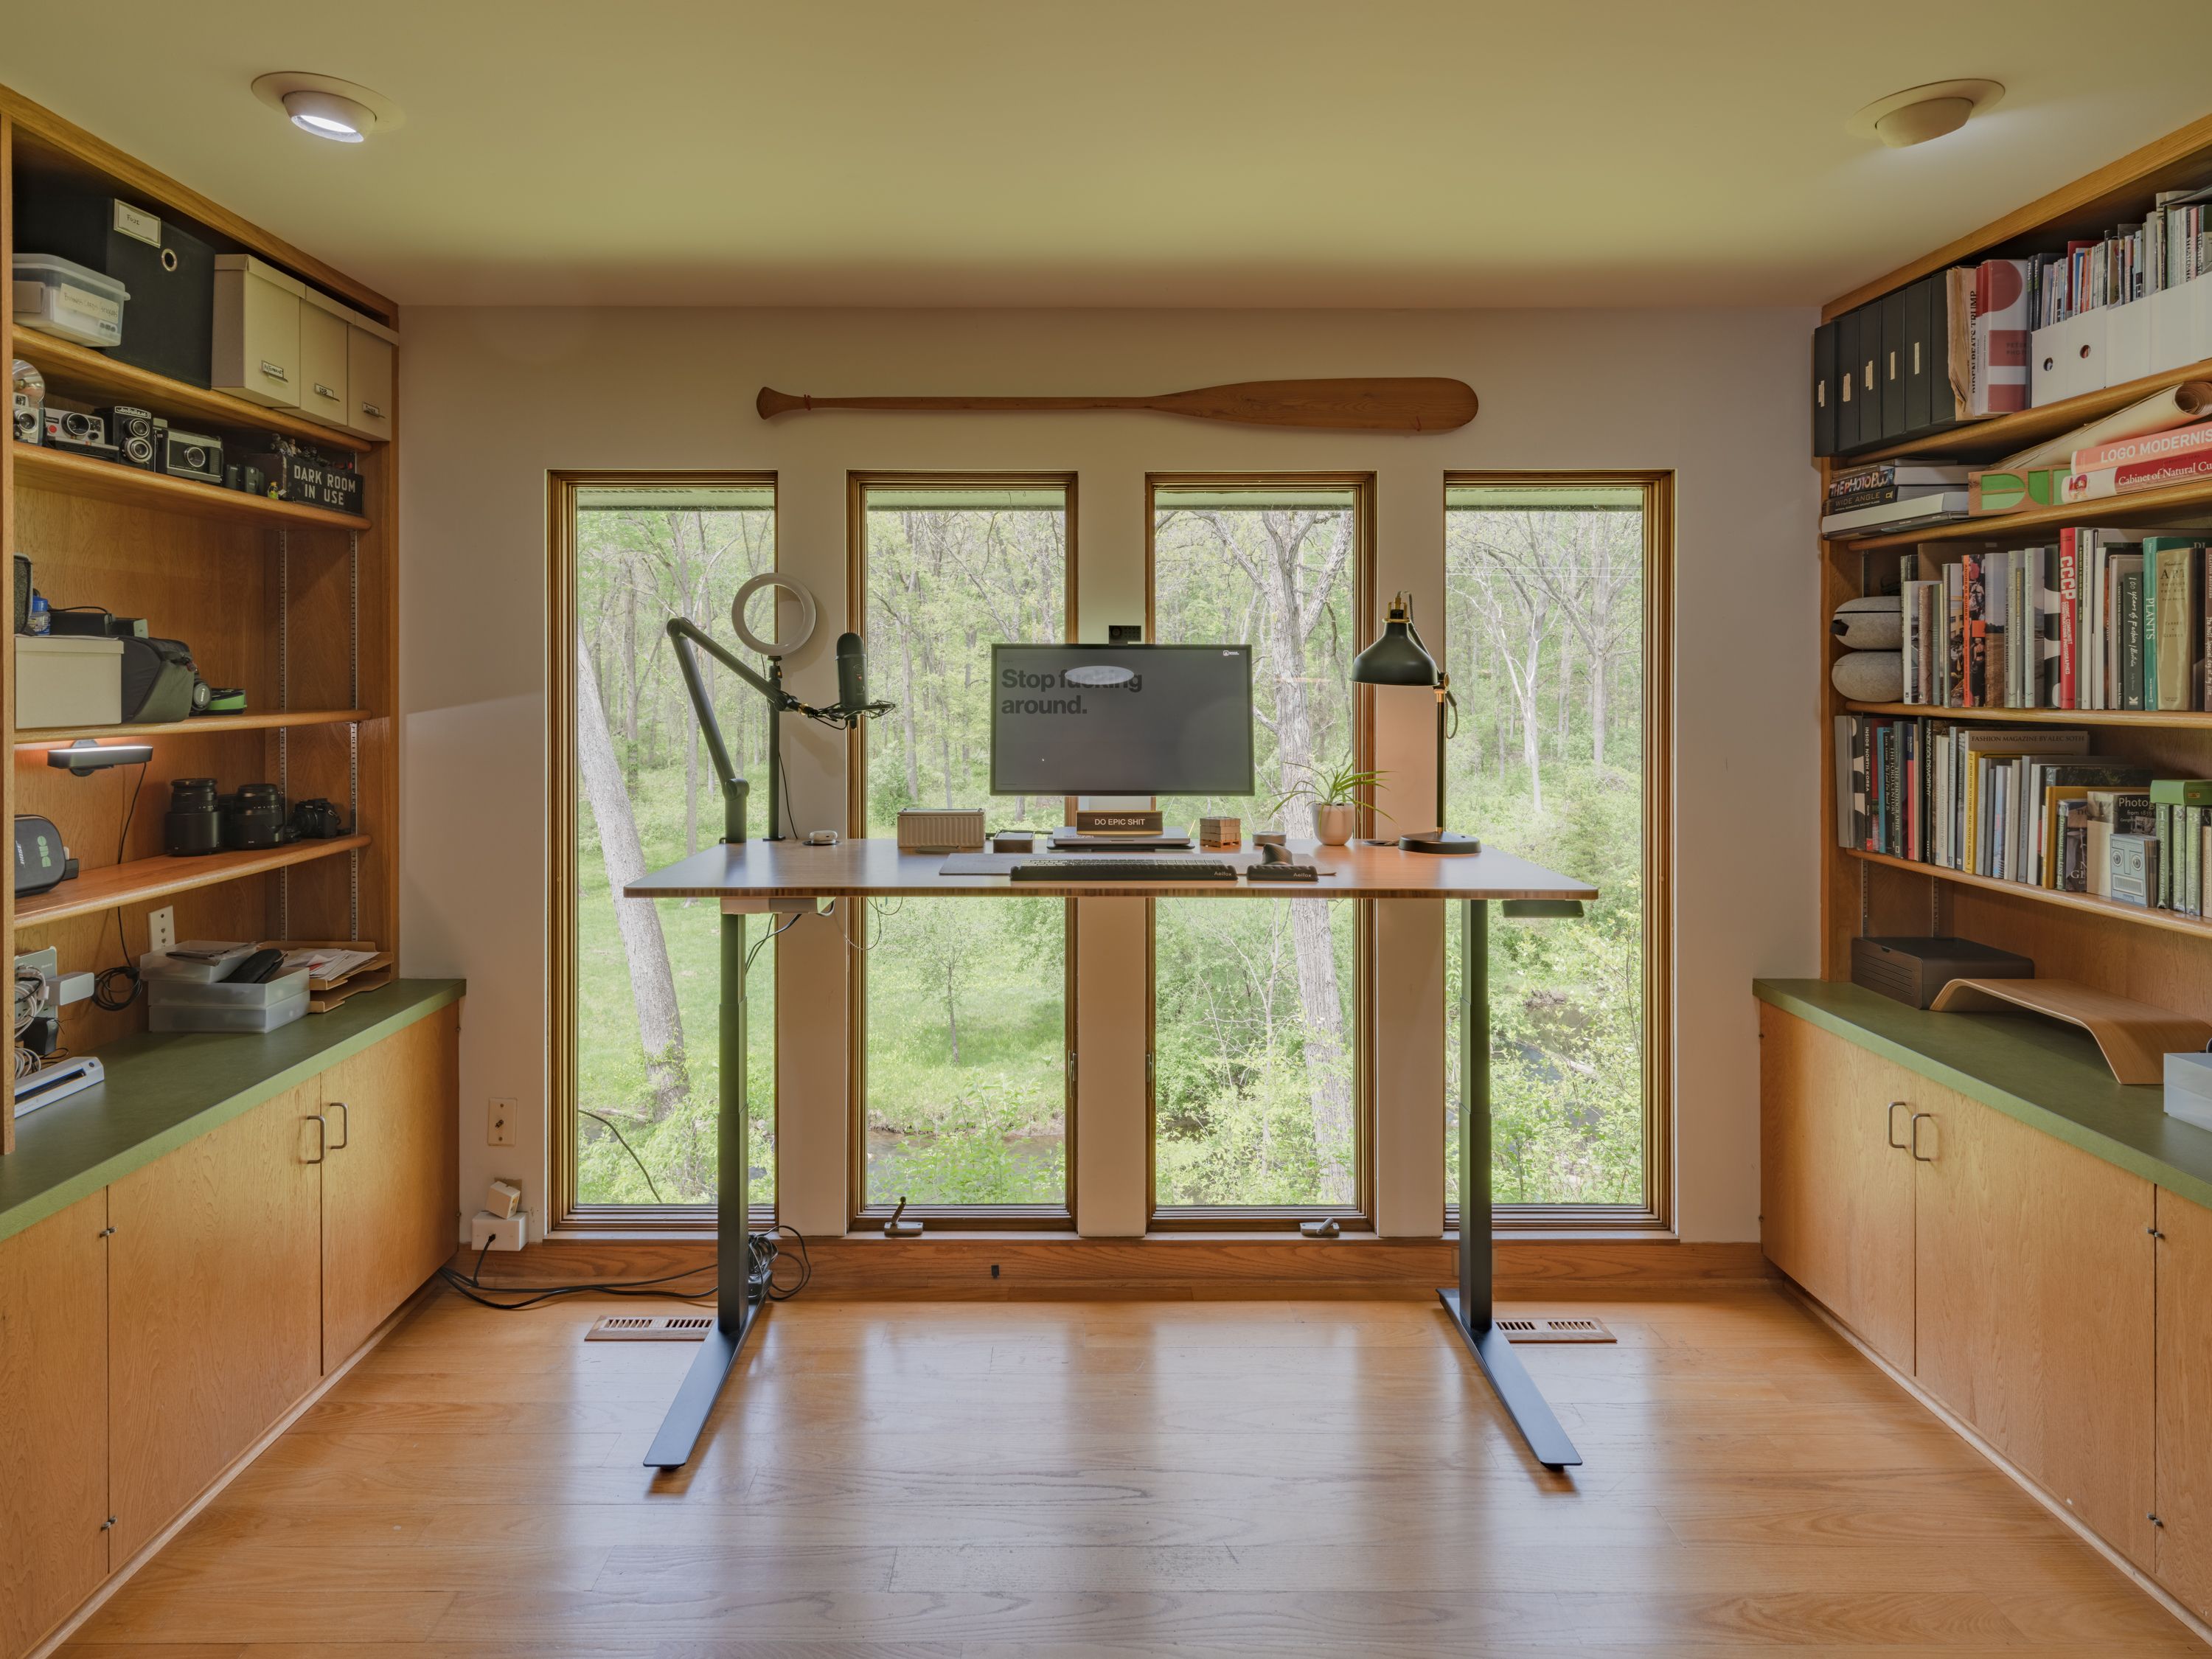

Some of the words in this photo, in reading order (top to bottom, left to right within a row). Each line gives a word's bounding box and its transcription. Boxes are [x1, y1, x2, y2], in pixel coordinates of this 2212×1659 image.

[2101, 445, 2136, 463] LOGO
[293, 465, 322, 485] DARK
[327, 473, 356, 493] ROOM
[2118, 473, 2149, 486] Cabinet
[2152, 468, 2163, 480] of
[2163, 462, 2197, 478] Natural
[305, 484, 316, 499] IN
[324, 488, 344, 506] USE
[1836, 497, 1853, 507] WIDE
[1854, 492, 1880, 502] ANGLE
[2060, 555, 2076, 600] CCCP
[2129, 577, 2137, 589] 100
[2126, 591, 2138, 611] years
[2146, 597, 2155, 640] PLANTS
[2127, 620, 2138, 644] Fashion
[1001, 669, 1055, 692] Stop
[1058, 669, 1142, 692] fung
[1001, 695, 1088, 714] around.
